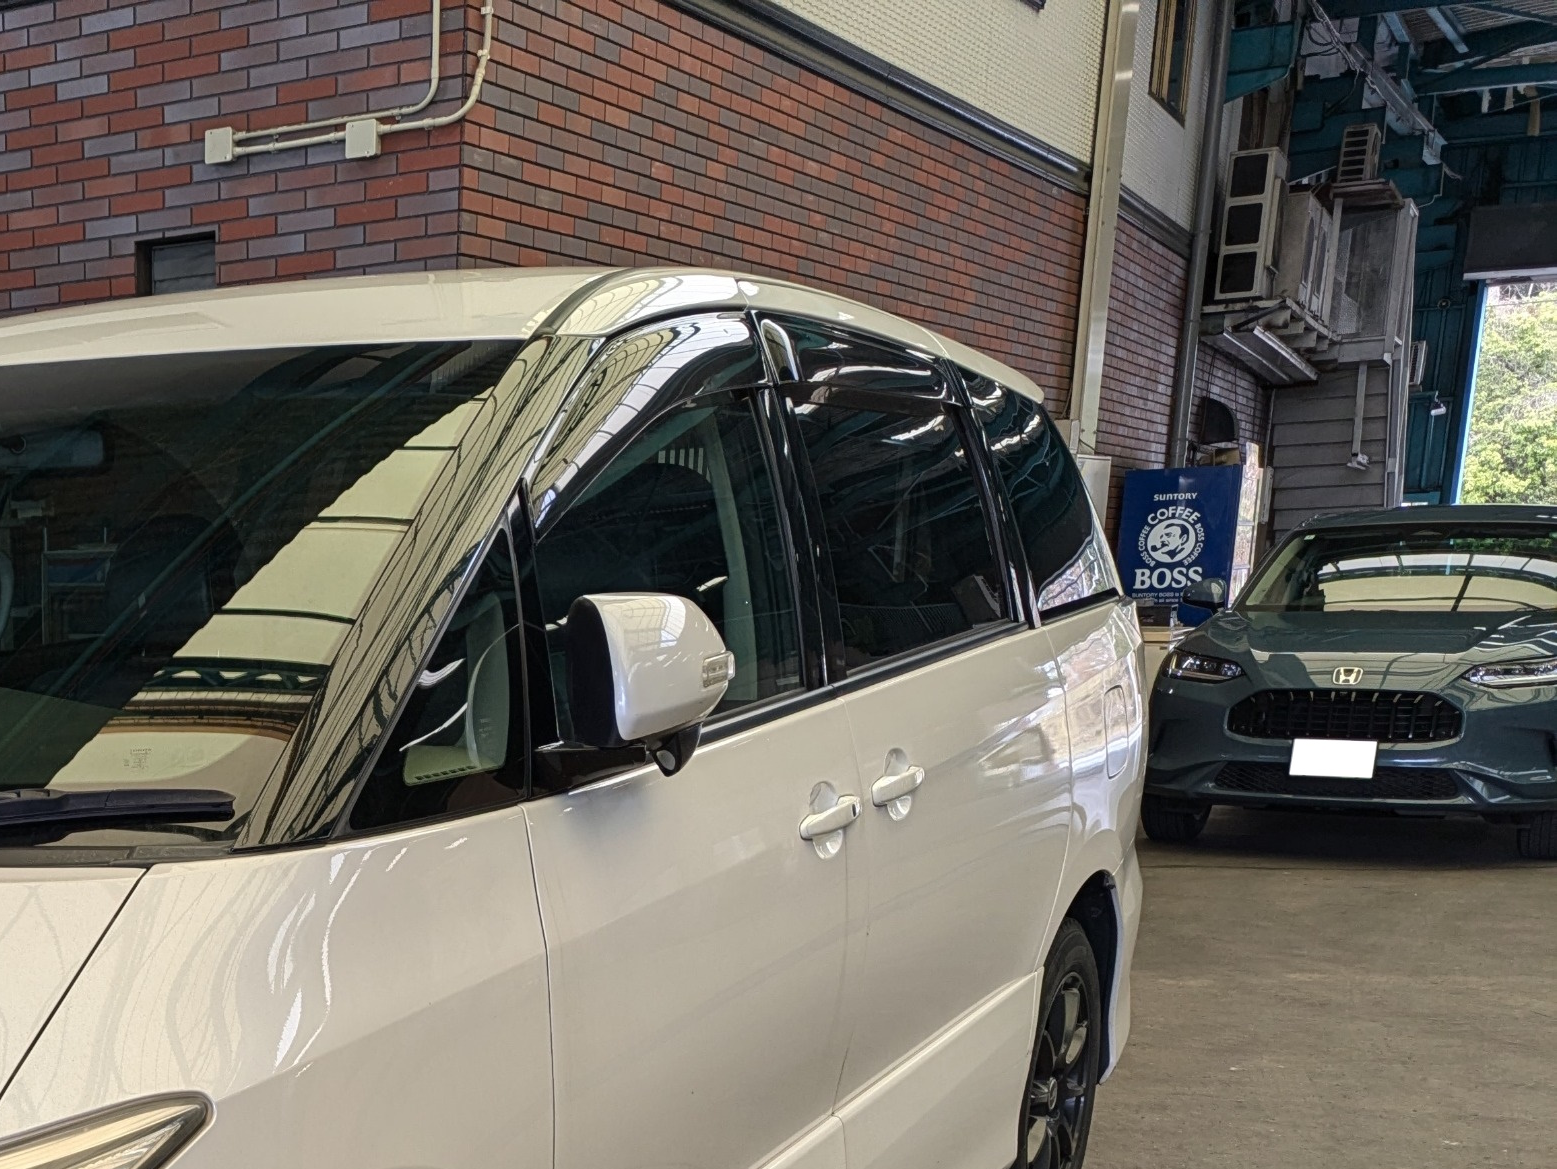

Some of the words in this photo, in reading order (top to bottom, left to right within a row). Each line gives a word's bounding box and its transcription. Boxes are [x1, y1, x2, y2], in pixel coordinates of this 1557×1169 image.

[1147, 506, 1201, 525] COFFEE
[1138, 525, 1151, 551] COFFEE
[1194, 522, 1205, 541] BOSS
[1140, 551, 1156, 567] BOSS
[1182, 542, 1204, 566] COFFEE
[1132, 566, 1203, 589] BOSS
